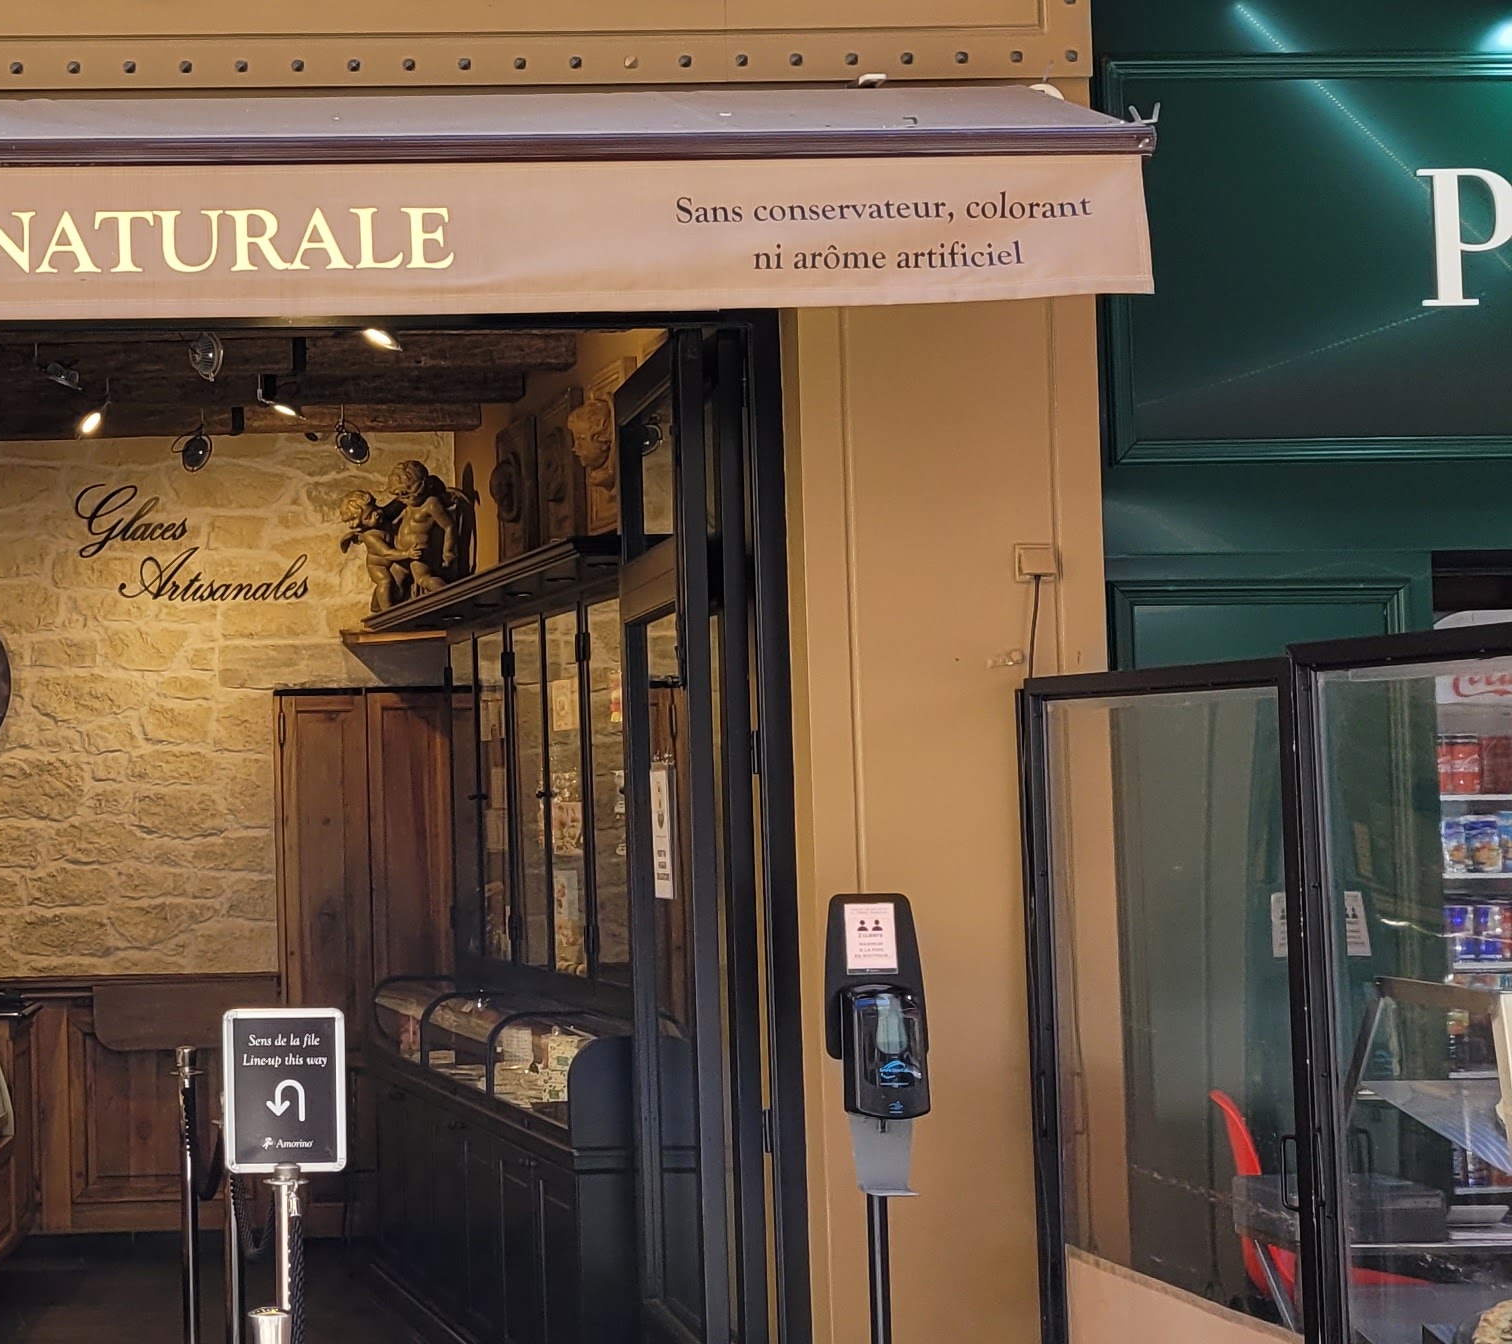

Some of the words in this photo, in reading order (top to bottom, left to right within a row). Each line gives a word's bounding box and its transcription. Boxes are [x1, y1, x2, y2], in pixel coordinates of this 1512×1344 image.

[675, 196, 743, 224] Sans
[753, 199, 956, 225] conservateur,
[965, 190, 1092, 221] colorant
[753, 244, 784, 270] ni
[793, 243, 887, 270] arôme
[896, 240, 1024, 271] artificiel
[75, 483, 188, 558] Glaces
[117, 546, 309, 603] Artisanales
[248, 1033, 272, 1047] Sens
[274, 1033, 288, 1046] de
[290, 1033, 300, 1046] la
[302, 1033, 321, 1048] file
[285, 1053, 304, 1066] this
[306, 1056, 328, 1068] way
[275, 1138, 314, 1150] Amorino
